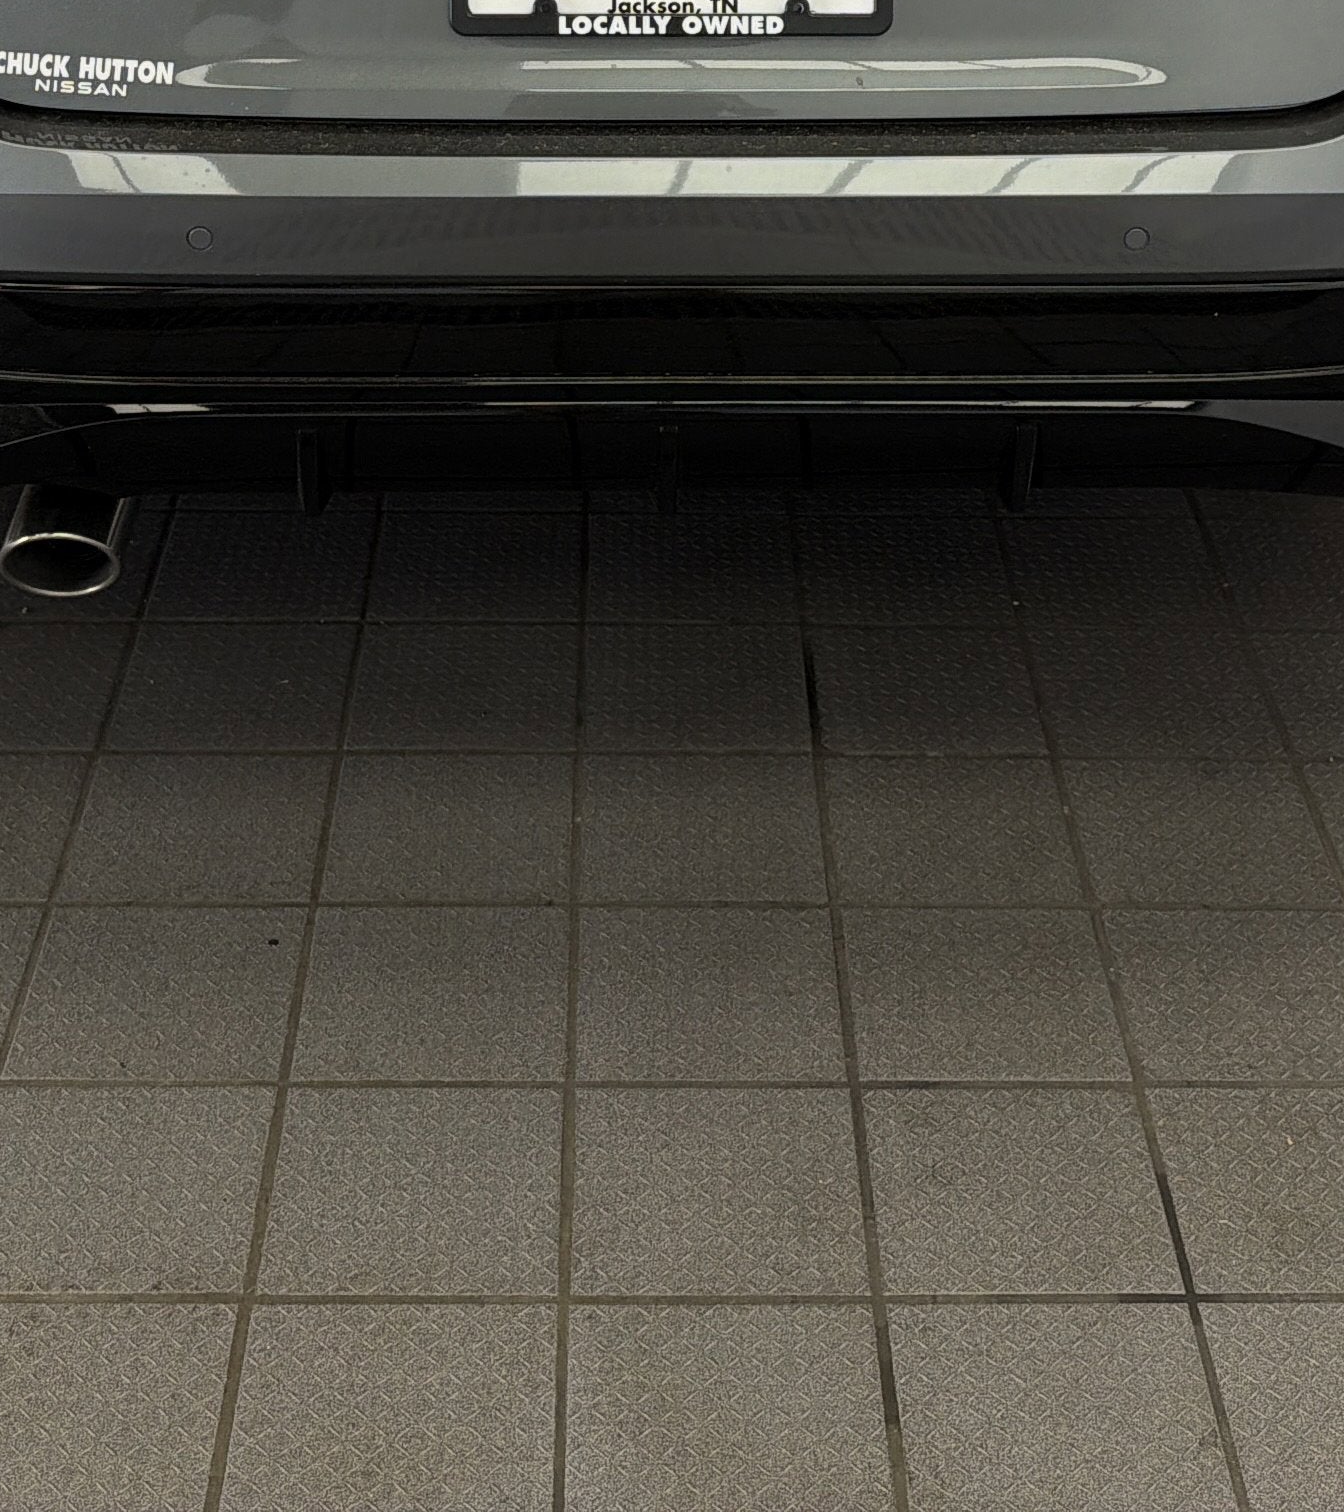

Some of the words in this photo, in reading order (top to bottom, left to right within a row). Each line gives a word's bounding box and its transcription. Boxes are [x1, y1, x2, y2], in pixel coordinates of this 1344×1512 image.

[558, 15, 671, 35] LOCALLY
[681, 15, 785, 35] OWNED
[78, 56, 175, 85] HUTTON
[34, 78, 128, 97] NISSAN
